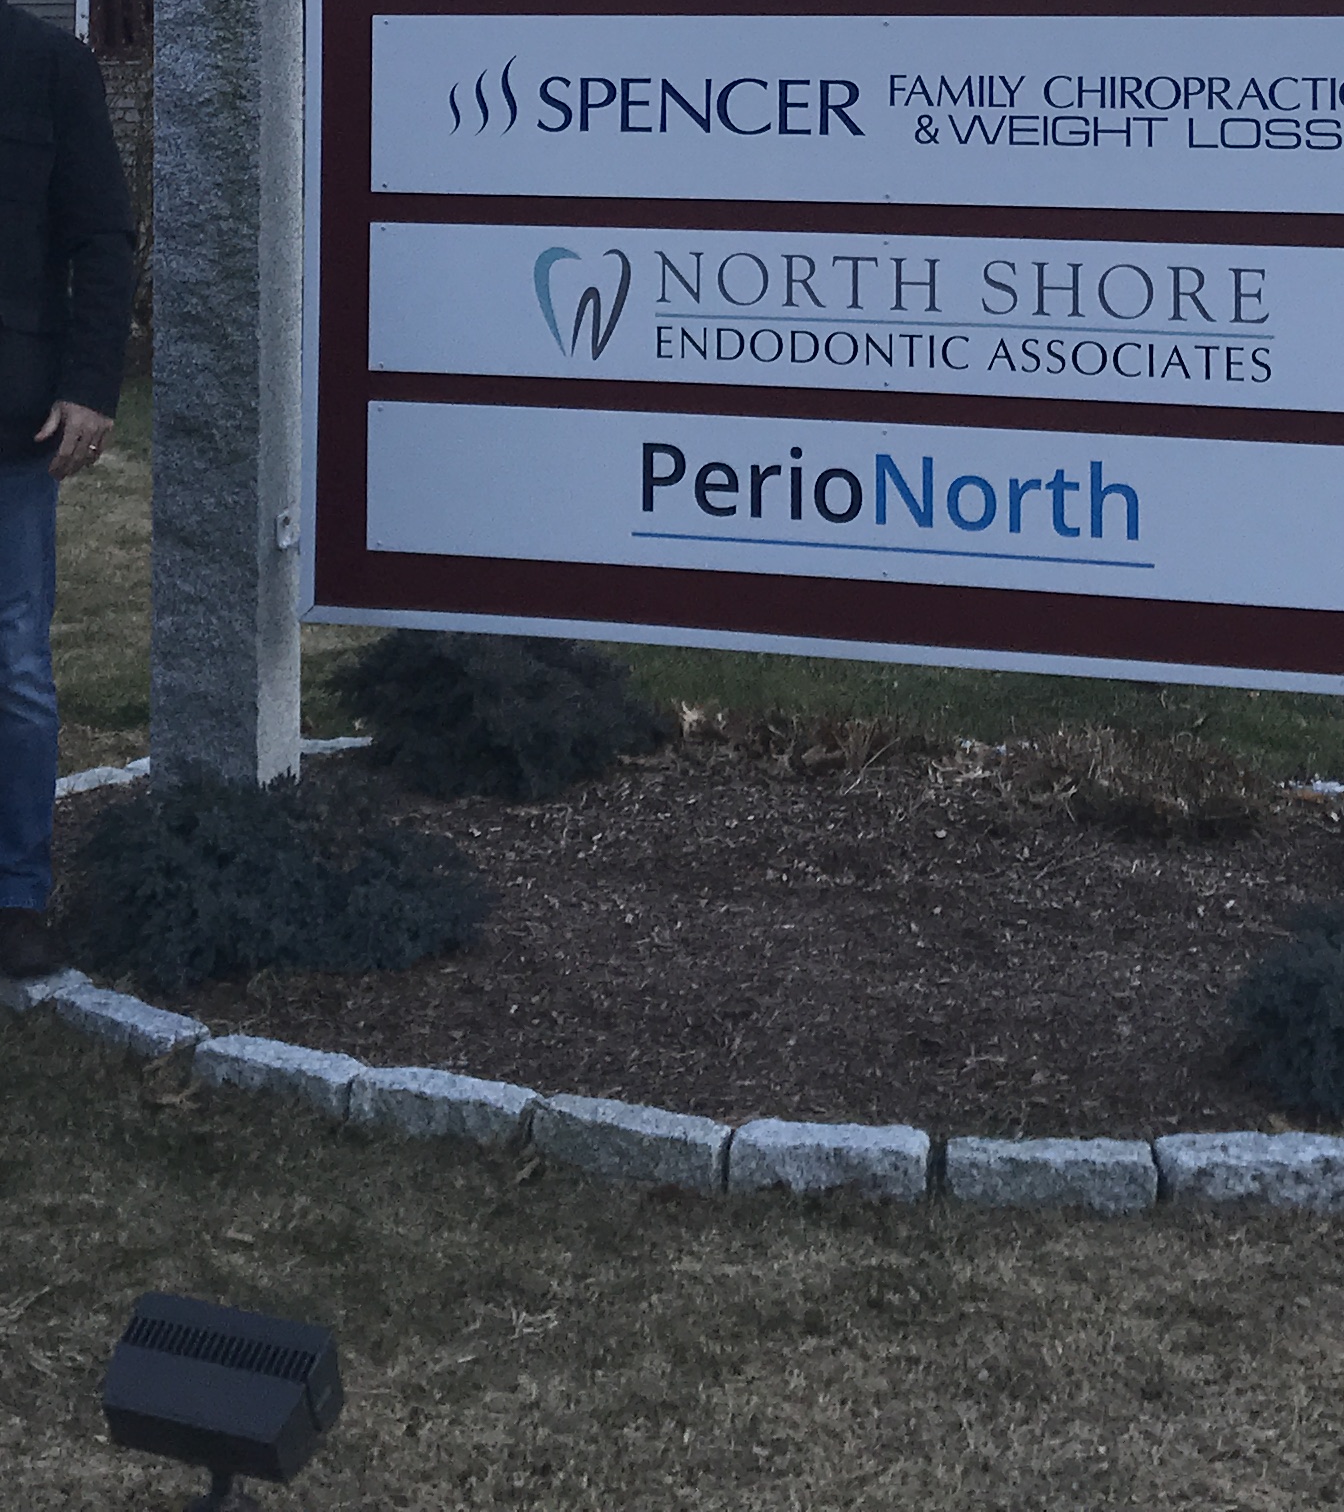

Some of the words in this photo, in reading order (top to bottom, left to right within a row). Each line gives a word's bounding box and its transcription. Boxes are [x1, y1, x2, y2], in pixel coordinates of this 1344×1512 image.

[536, 75, 867, 138] SPENCER
[889, 74, 1027, 109] FAMILY
[1188, 117, 1343, 151] LOSS
[653, 250, 943, 313] NORTH
[981, 259, 1270, 325] SHORE
[656, 325, 970, 371] ENDODONTIC
[986, 337, 1272, 384] ASSOCIATES
[641, 441, 1140, 542] PerioNorth
